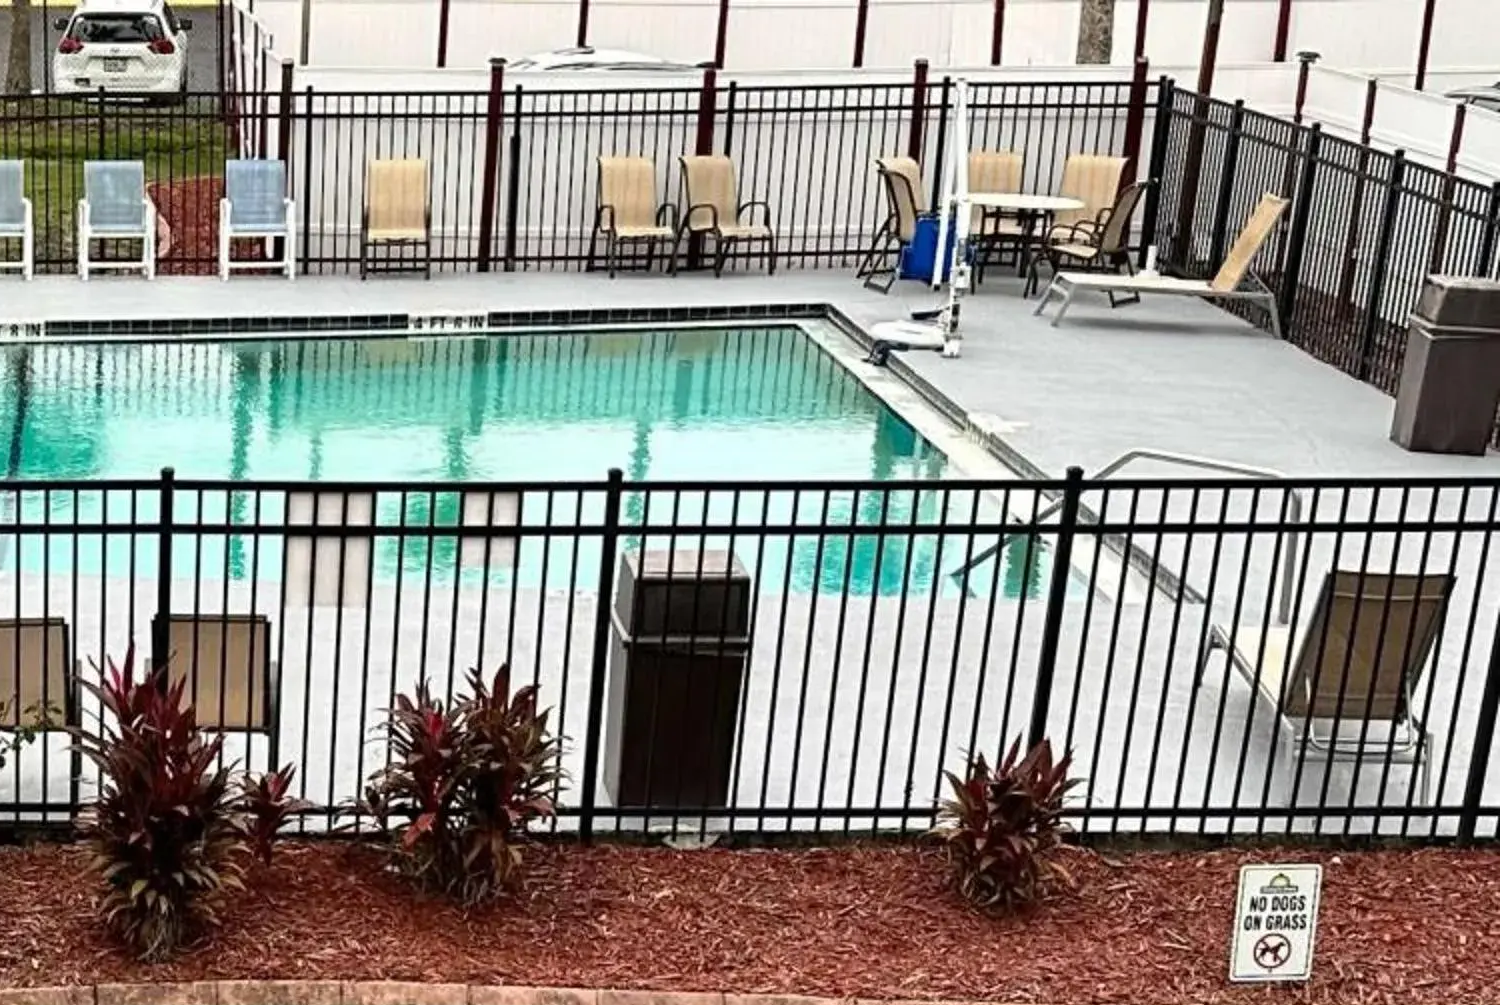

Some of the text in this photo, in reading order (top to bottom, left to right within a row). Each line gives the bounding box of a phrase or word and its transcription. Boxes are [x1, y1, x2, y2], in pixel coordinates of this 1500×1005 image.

[430, 315, 447, 329] FT
[469, 315, 485, 329] IN
[25, 323, 41, 337] IN
[1250, 895, 1306, 912] NO DOGS
[1244, 914, 1307, 931] ON GRASS
